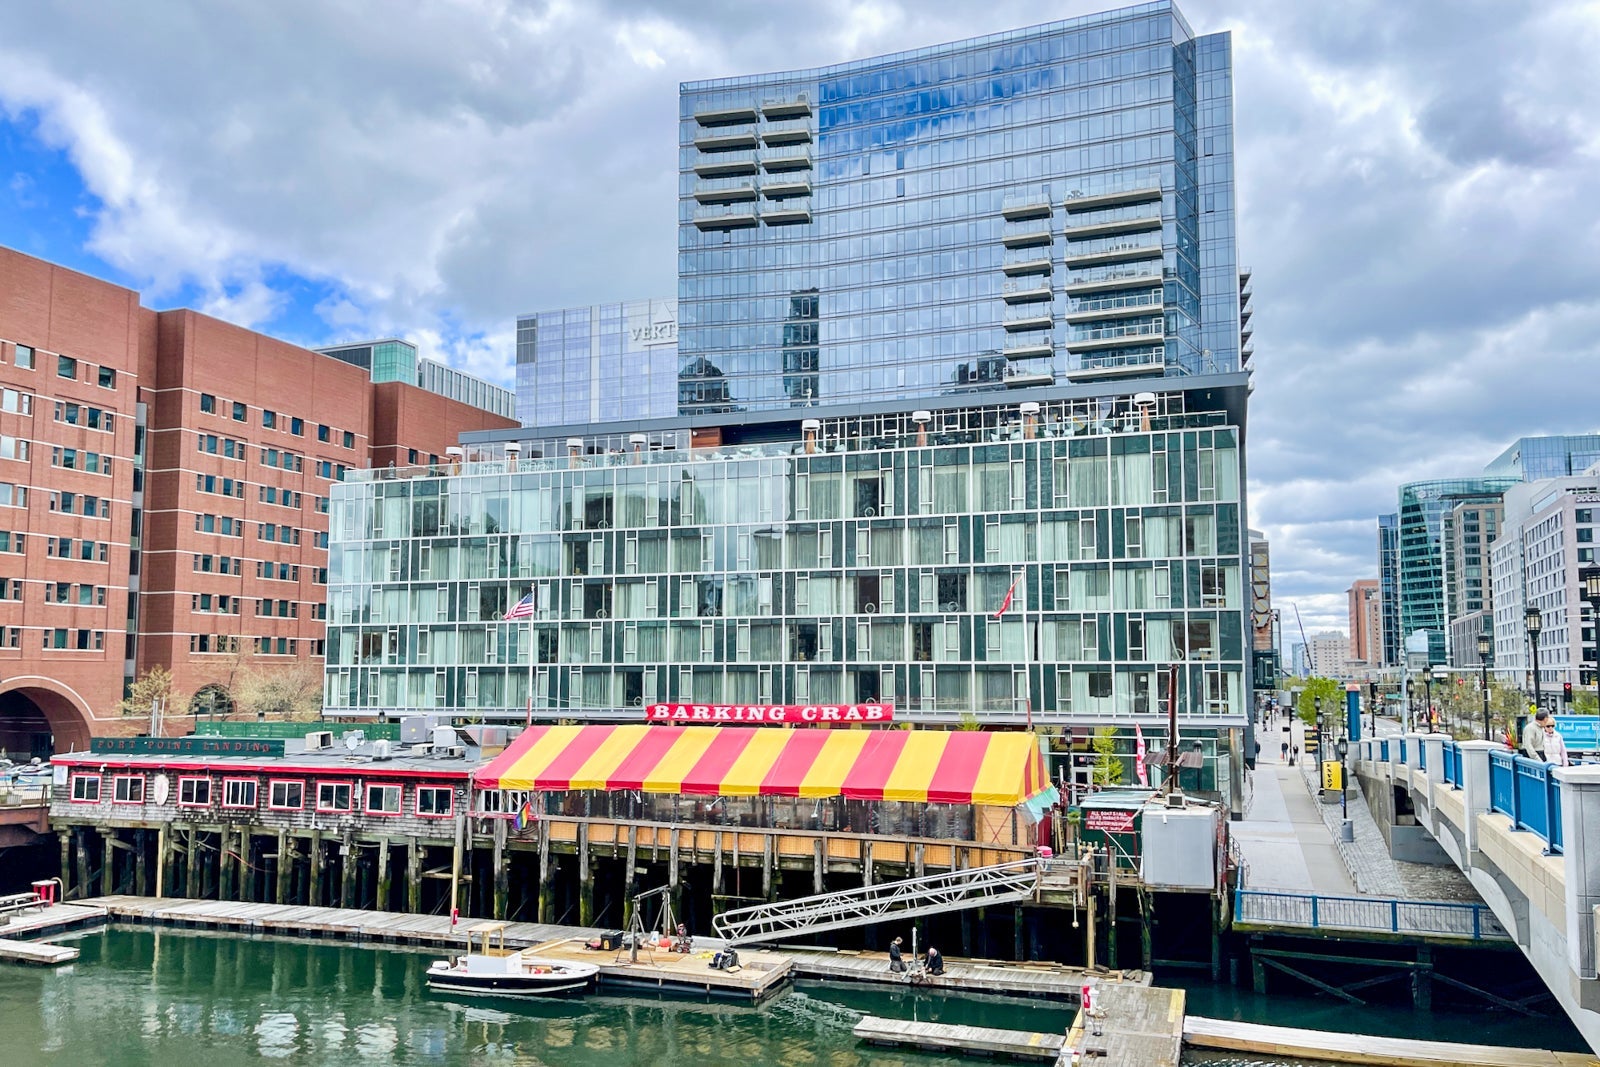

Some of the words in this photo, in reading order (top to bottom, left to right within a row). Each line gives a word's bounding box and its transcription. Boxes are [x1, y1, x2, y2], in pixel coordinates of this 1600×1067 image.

[653, 705, 786, 721] BARKING
[801, 705, 884, 721] CRAB
[1575, 725, 1590, 733] your
[97, 740, 136, 750] FORT
[148, 741, 193, 751] POINT
[203, 742, 272, 753] LANDING
